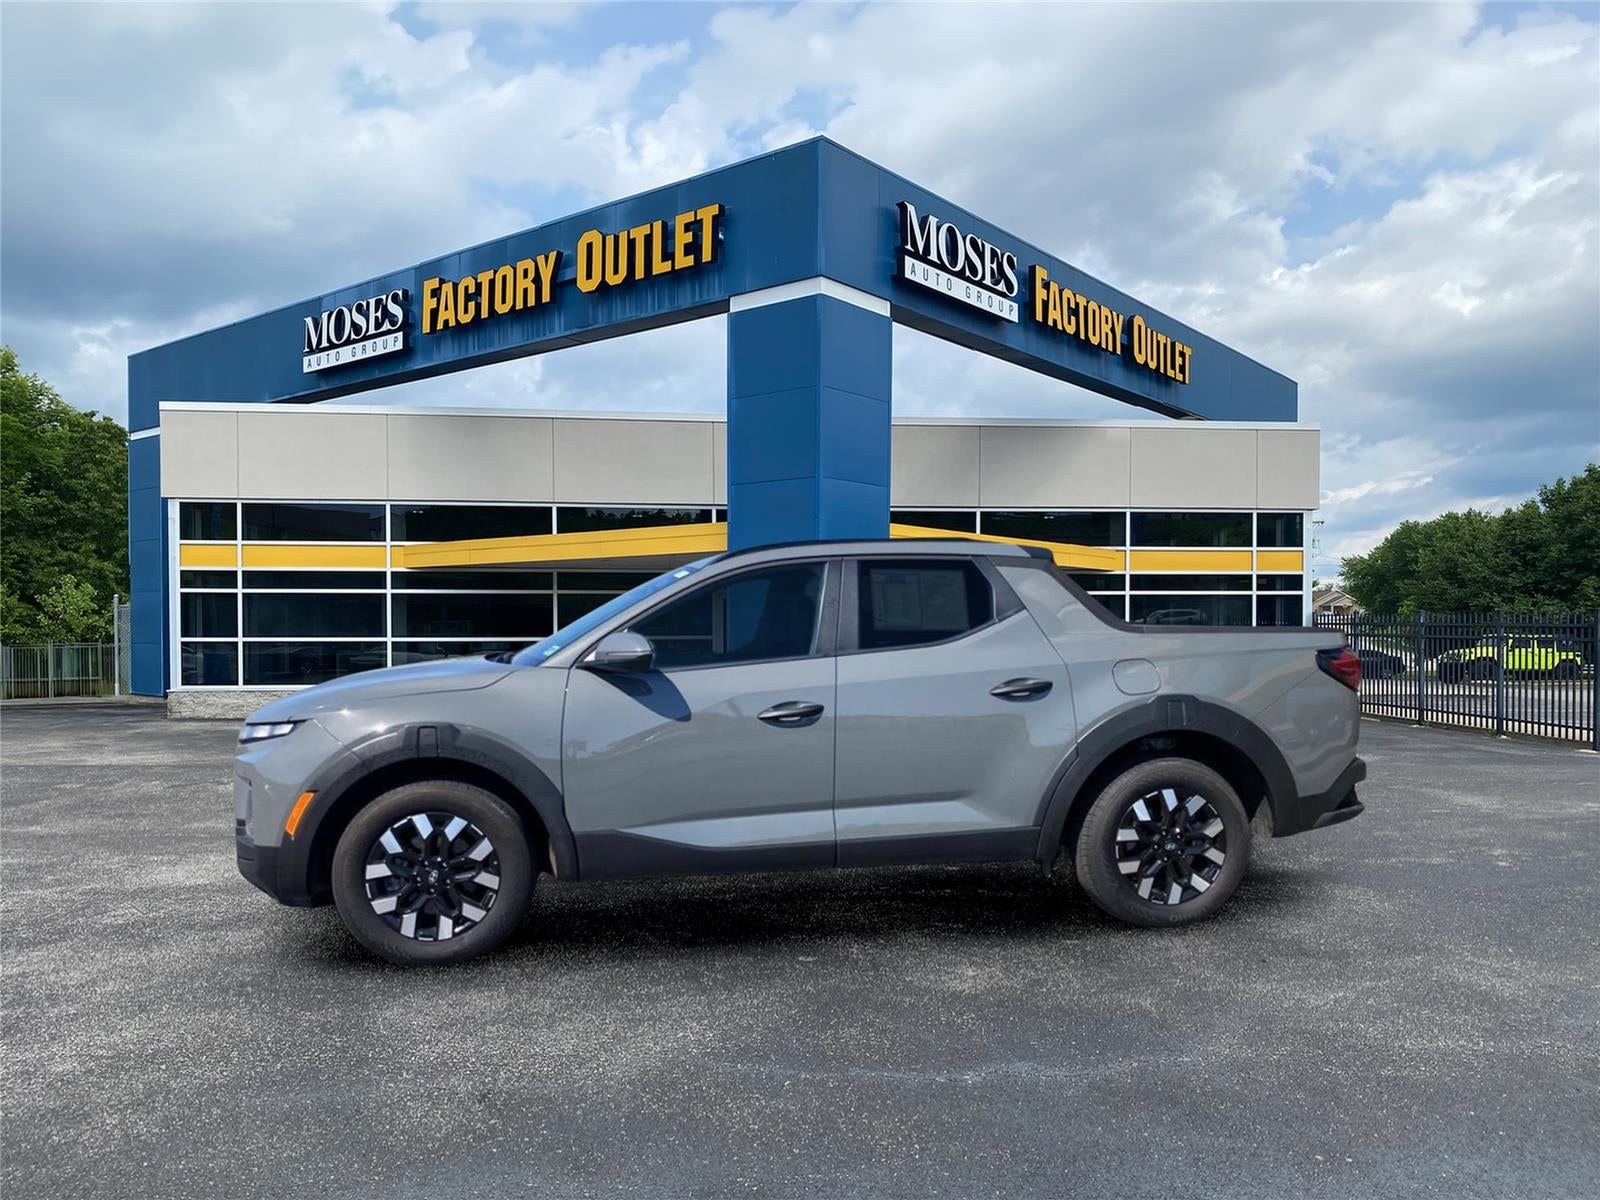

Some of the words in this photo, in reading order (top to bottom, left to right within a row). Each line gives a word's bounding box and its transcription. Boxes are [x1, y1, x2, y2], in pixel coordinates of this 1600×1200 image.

[422, 249, 558, 334] FACTORY
[576, 203, 720, 294] OUTLET
[901, 201, 1019, 298] MOSES
[909, 262, 953, 292] AUTO
[964, 285, 1016, 316] GROUP
[303, 288, 404, 353] MOSES
[306, 348, 341, 370] AUTO
[350, 335, 400, 358] GROUP
[1033, 264, 1125, 355] FACTORY
[1132, 313, 1193, 385] OUTLET
